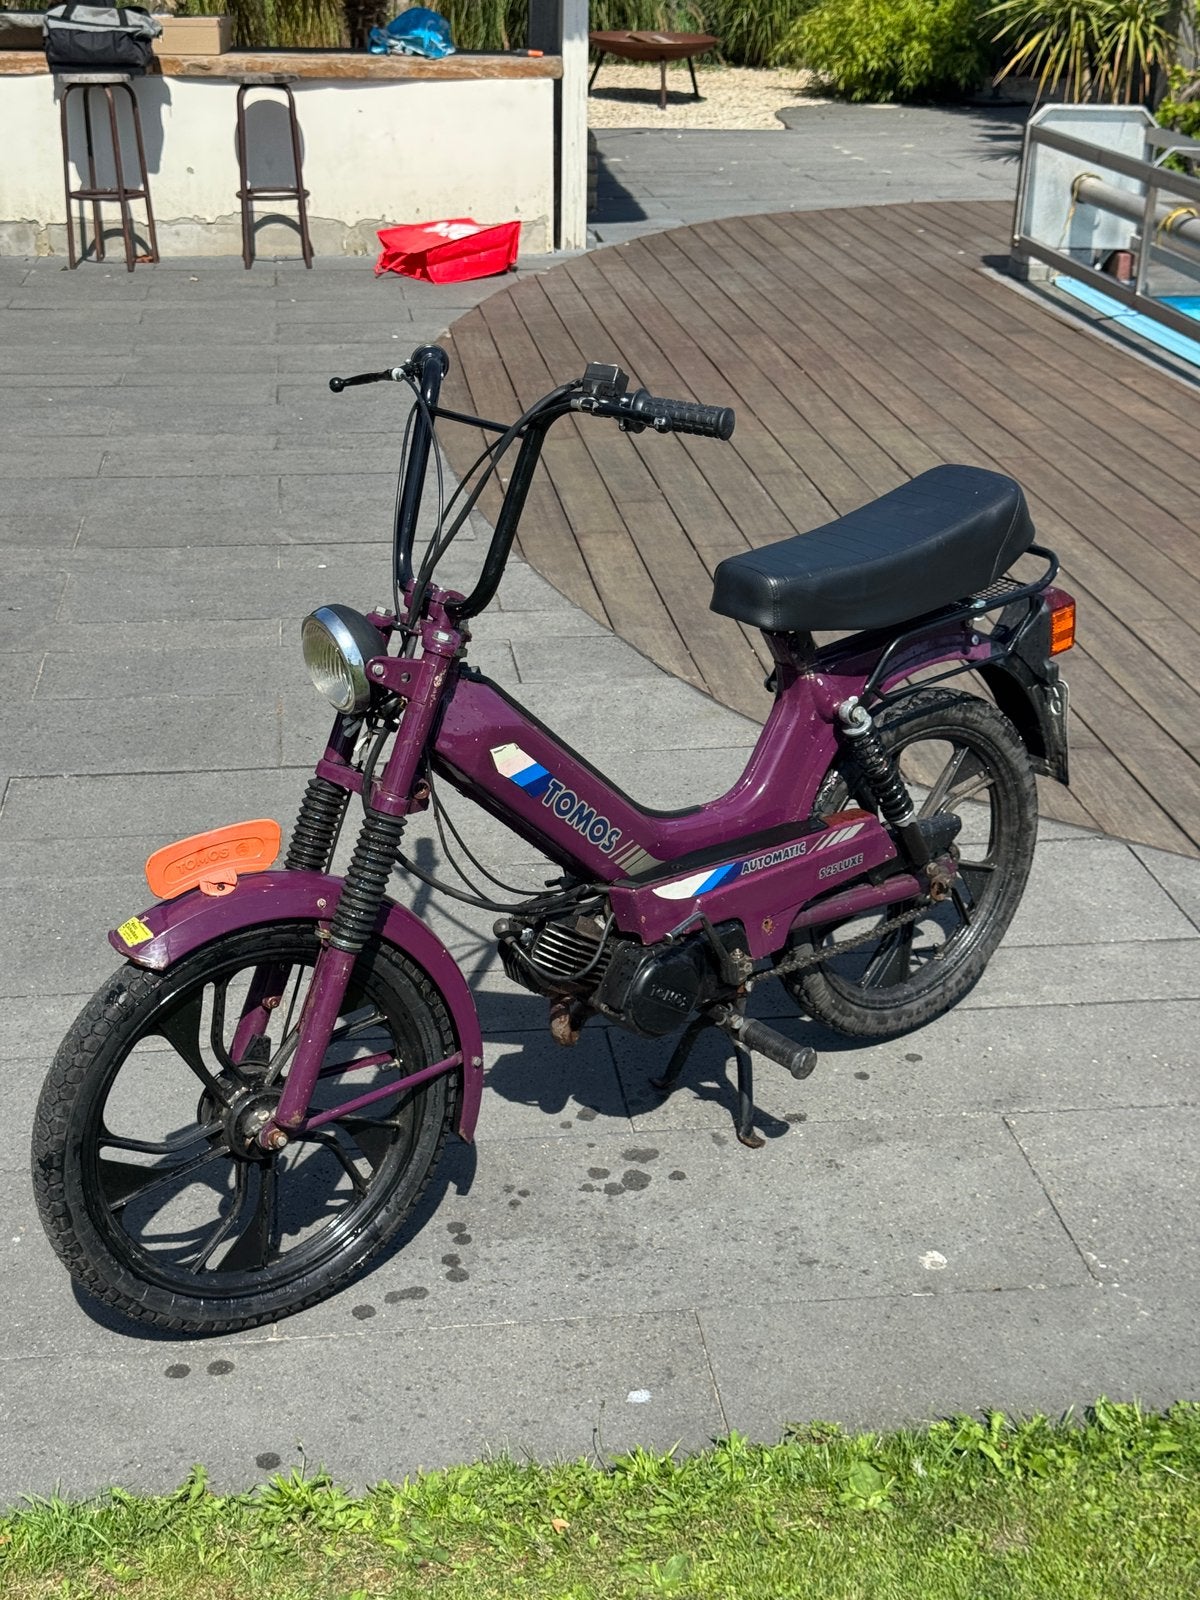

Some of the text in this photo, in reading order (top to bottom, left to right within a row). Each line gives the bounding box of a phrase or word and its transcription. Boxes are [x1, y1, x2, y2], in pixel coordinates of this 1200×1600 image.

[542, 778, 622, 853] TOMOS
[176, 848, 229, 874] TOMOS
[740, 842, 807, 875] AUTOMATIC
